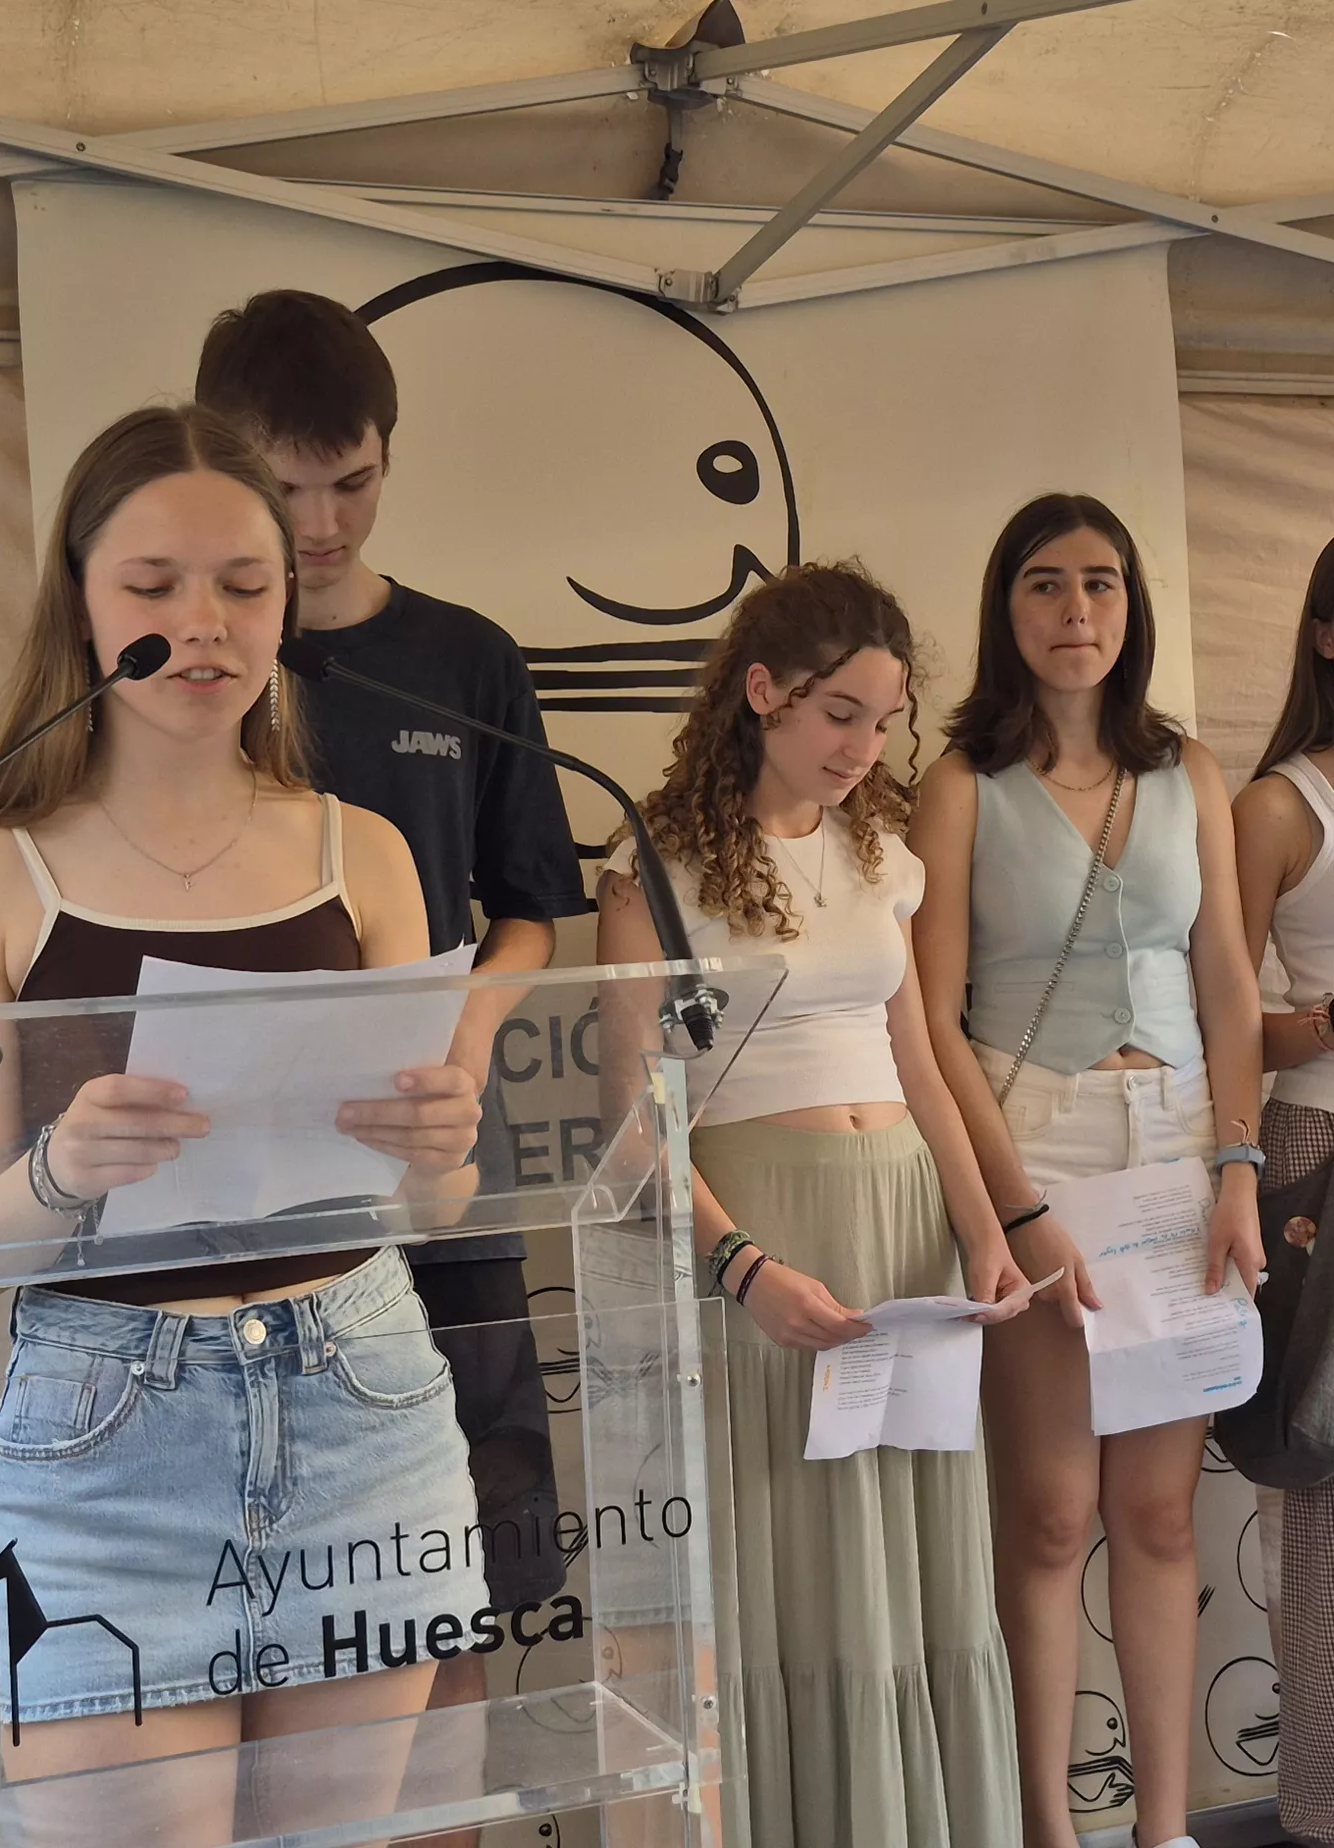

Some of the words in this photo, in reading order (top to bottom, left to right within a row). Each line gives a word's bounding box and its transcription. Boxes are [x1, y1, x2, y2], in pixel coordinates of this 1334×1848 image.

[391, 730, 462, 760] JAWS
[206, 1486, 694, 1618] Ayuntamiento
[208, 1629, 291, 1697] de
[320, 1594, 586, 1679] Huesca
